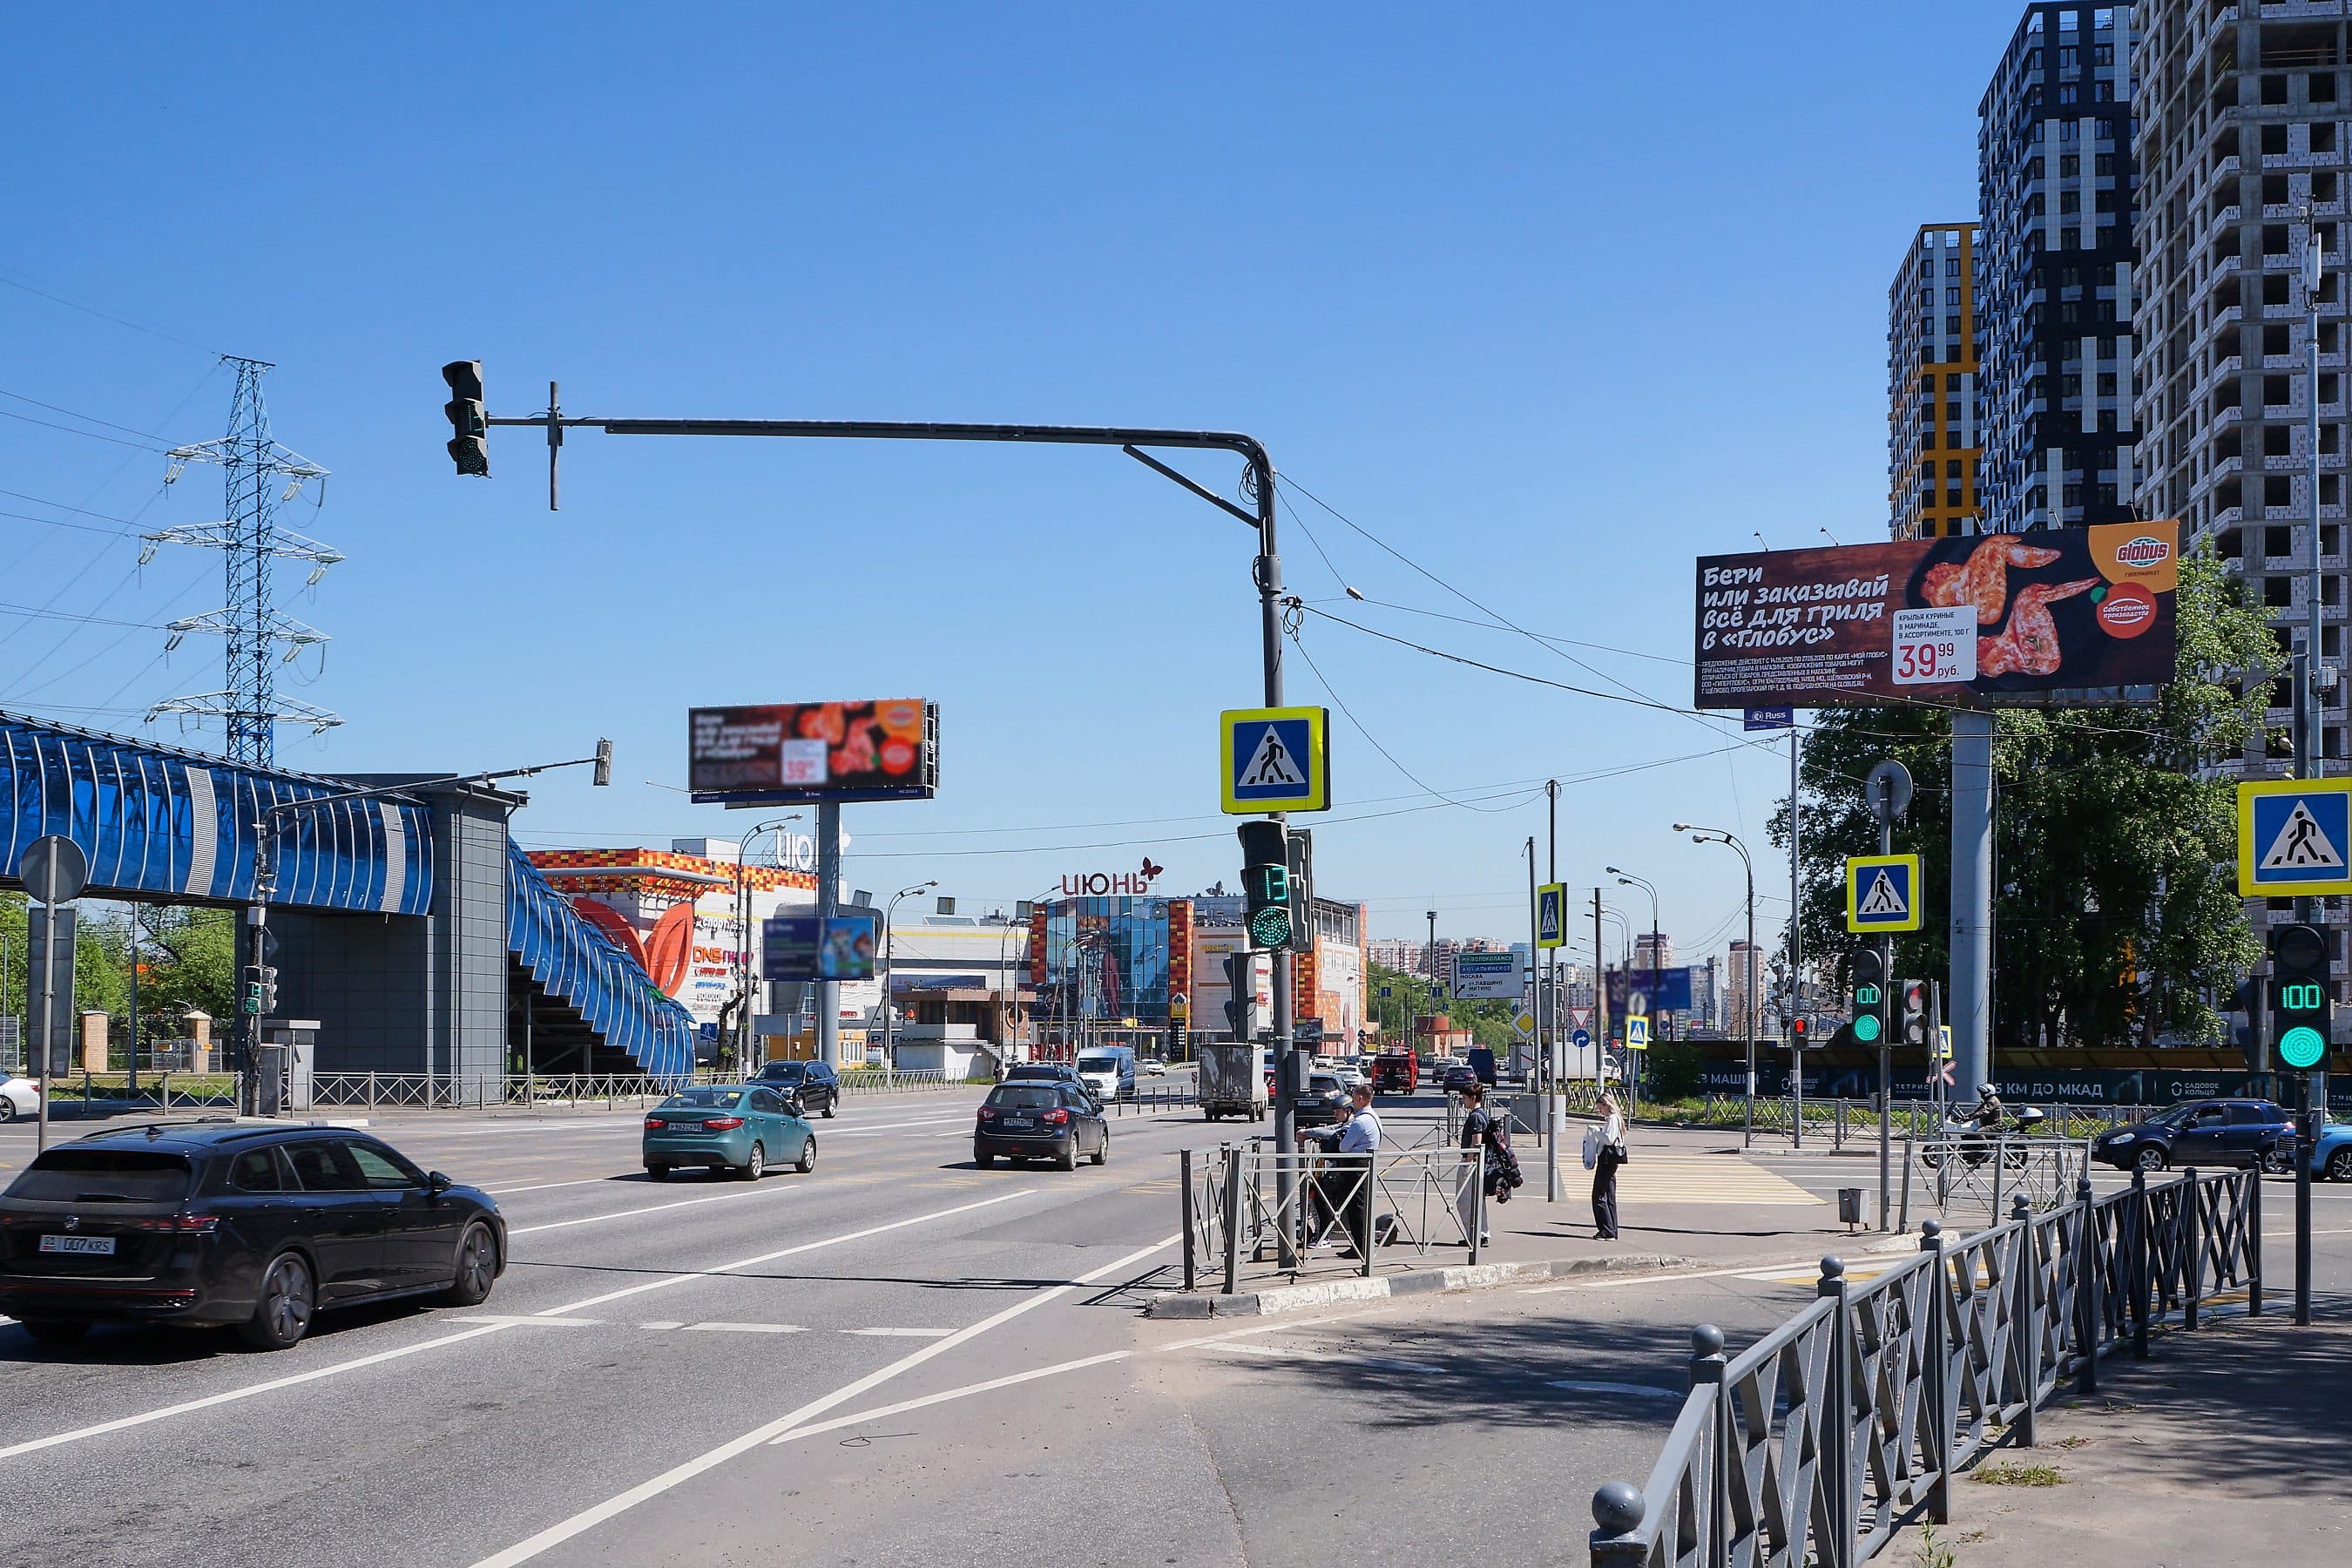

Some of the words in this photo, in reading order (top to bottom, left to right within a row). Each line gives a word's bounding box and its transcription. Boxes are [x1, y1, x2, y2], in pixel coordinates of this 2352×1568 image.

[1704, 567, 1763, 586] Бери
[1704, 589, 1749, 607] или
[1754, 573, 1889, 605] заказывай
[1703, 605, 1743, 629] всё
[1747, 608, 1801, 628] для
[1807, 602, 1885, 626] гриля
[1702, 631, 1717, 650] в
[1904, 630, 1952, 639] АССОРТИМЕНТЕ,
[1898, 644, 1936, 678] 39
[1938, 643, 1954, 657] 99
[1937, 665, 1959, 679] руб.
[1266, 867, 1288, 900] 13
[693, 946, 722, 963] DNS
[1856, 988, 1878, 1004] 100
[2283, 985, 2320, 1009] 100
[2006, 1083, 2027, 1094] КМ
[2031, 1083, 2054, 1097] ДО
[2058, 1084, 2103, 1098] МКАД
